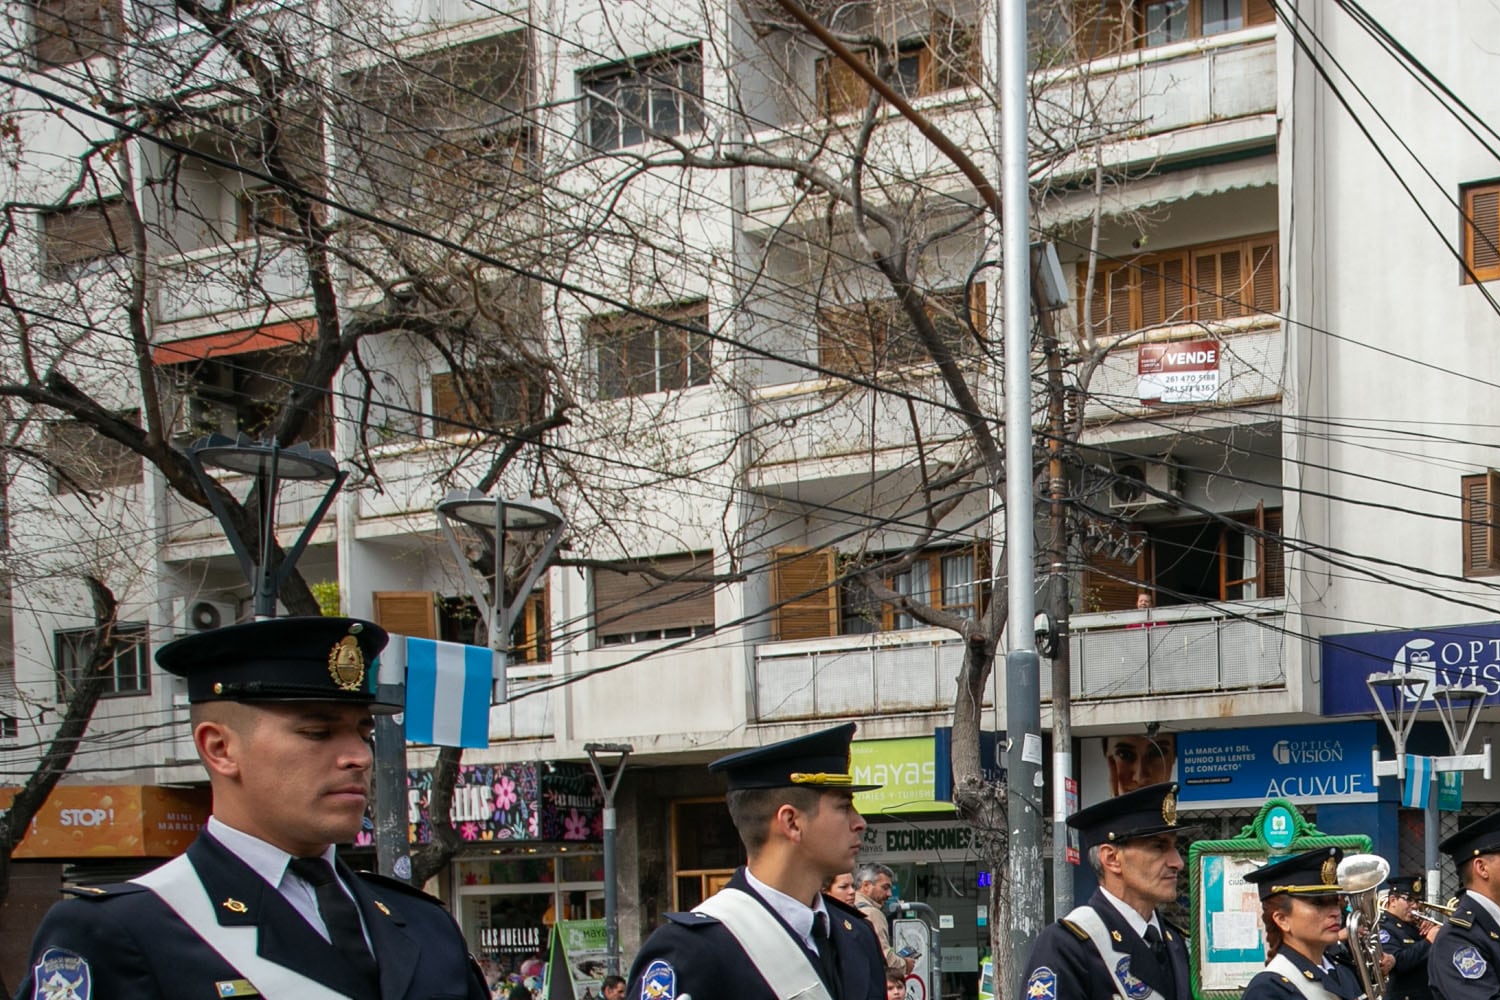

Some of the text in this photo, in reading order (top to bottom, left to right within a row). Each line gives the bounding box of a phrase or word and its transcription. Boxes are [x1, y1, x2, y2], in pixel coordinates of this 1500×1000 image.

[1167, 350, 1216, 365] VENDE
[1195, 747, 1223, 755] MARCA
[1290, 740, 1342, 750] OPTICA
[1184, 755, 1214, 764] MUNDO
[1227, 753, 1256, 762] LENTES
[1290, 749, 1343, 764] VISION
[1266, 774, 1363, 799] ACUVUE
[167, 813, 193, 821] MINI
[886, 828, 972, 851] EXCURSIONES
[482, 927, 540, 946] LAS HUELLAS
